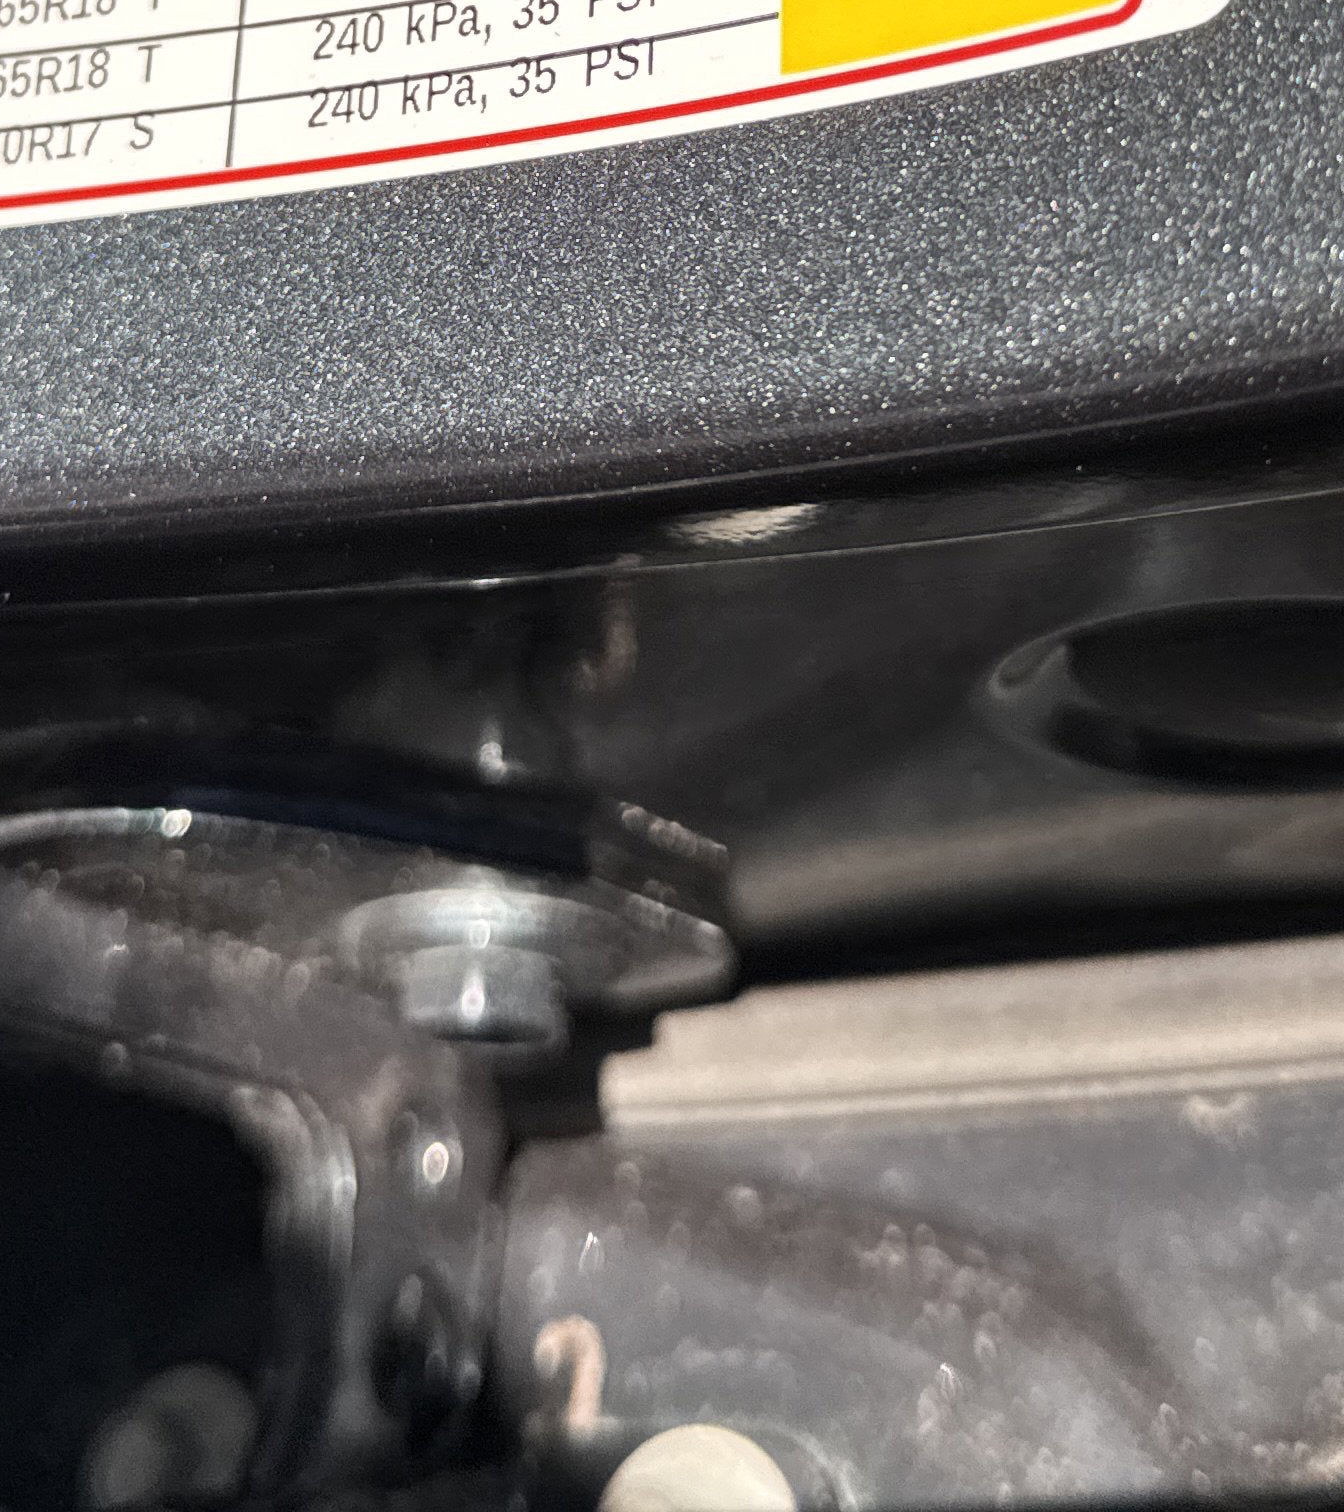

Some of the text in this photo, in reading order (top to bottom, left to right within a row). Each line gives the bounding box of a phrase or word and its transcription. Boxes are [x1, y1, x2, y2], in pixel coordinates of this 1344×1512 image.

[137, 44, 163, 83] T
[313, 11, 384, 61] 240
[406, 0, 492, 47] kPa,
[129, 111, 155, 149] S
[307, 88, 380, 128] 240
[401, 73, 488, 113] kPa,
[510, 56, 557, 99] 35
[586, 39, 655, 88] PSI
